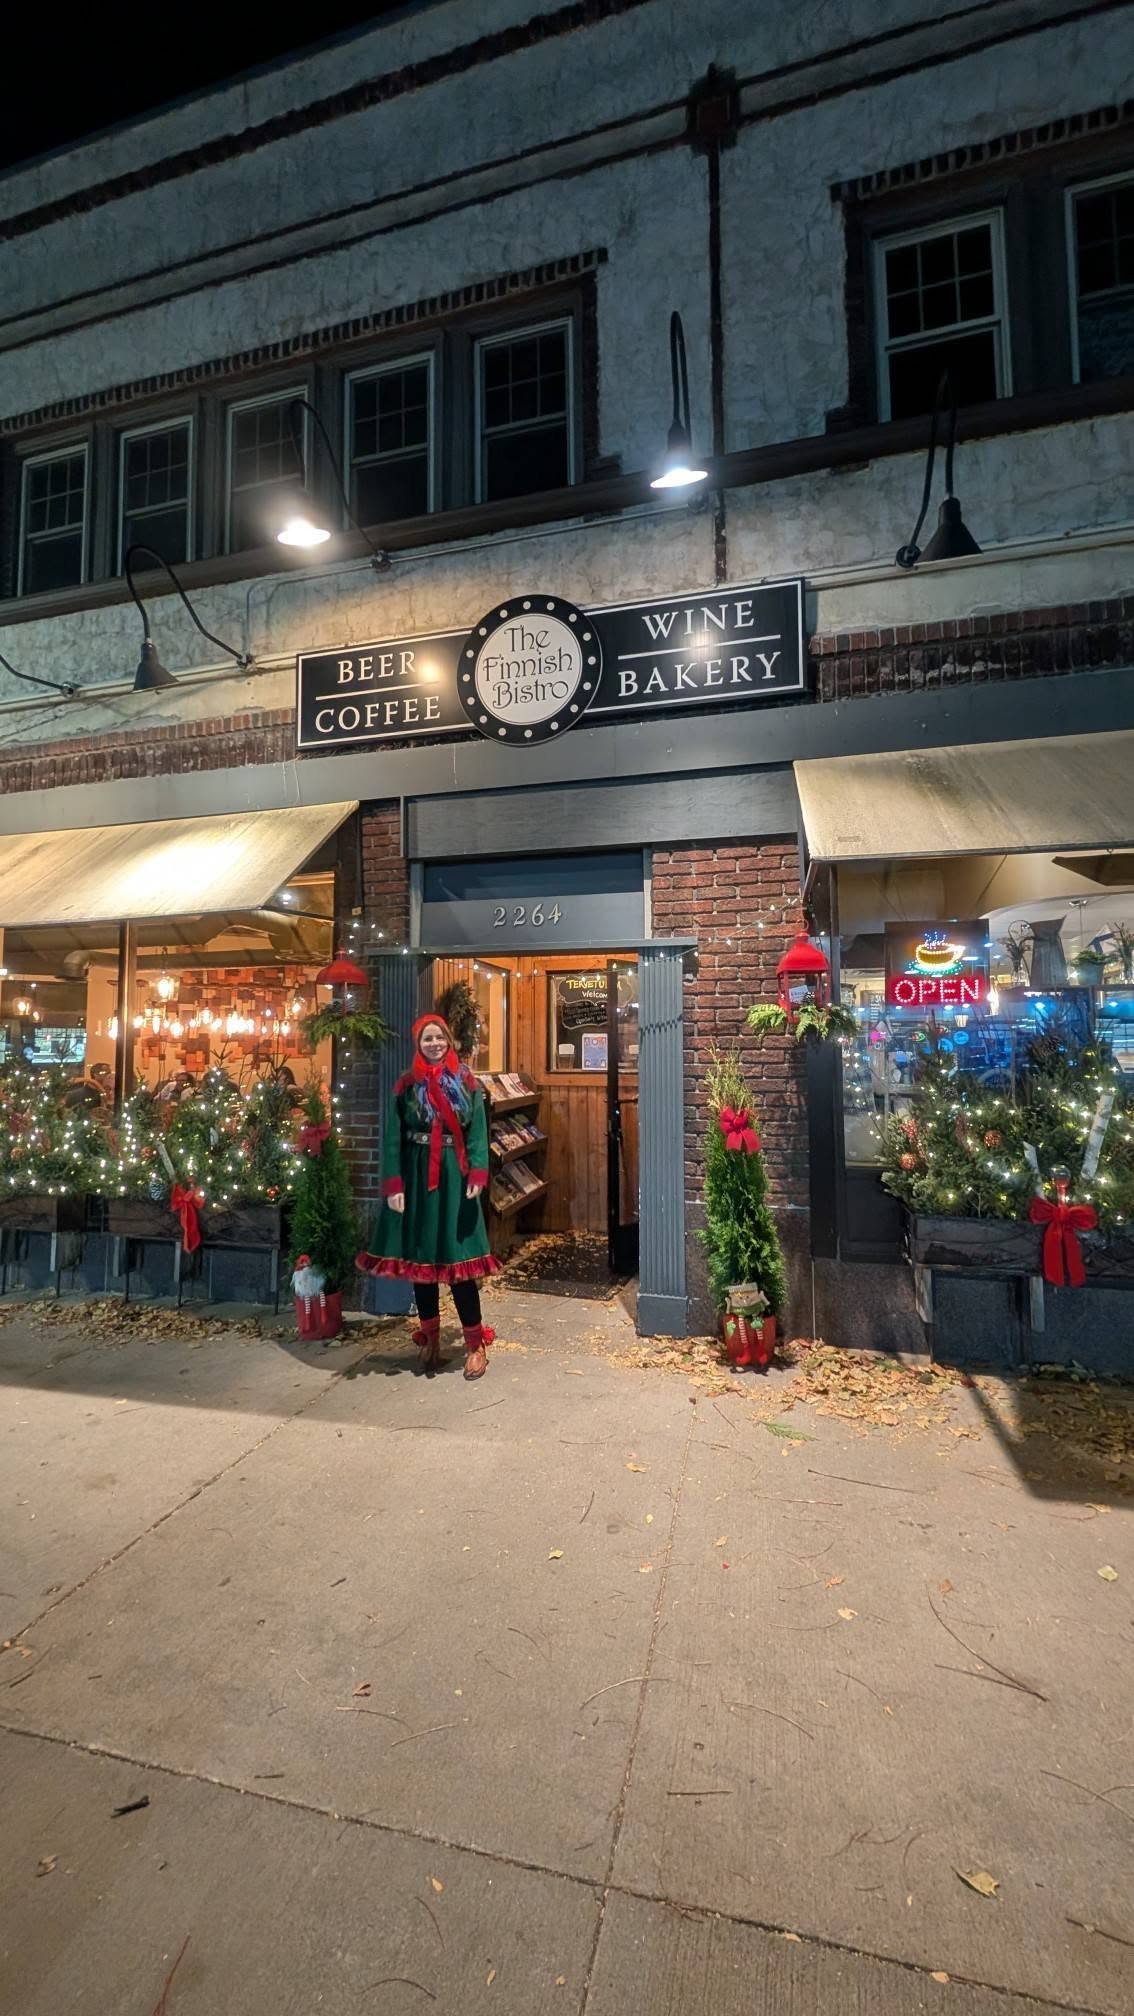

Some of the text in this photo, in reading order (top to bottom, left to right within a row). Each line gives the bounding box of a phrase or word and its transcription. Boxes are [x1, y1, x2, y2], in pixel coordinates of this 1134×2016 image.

[642, 600, 755, 640] WINE
[504, 624, 551, 653] The
[337, 651, 417, 684] BEER
[483, 647, 573, 682] Finnish
[618, 651, 782, 697] BAKERY
[492, 678, 569, 709] Bistro
[315, 696, 441, 733] COFFEE
[493, 904, 562, 928] 2264
[894, 979, 979, 1003] OPEN
